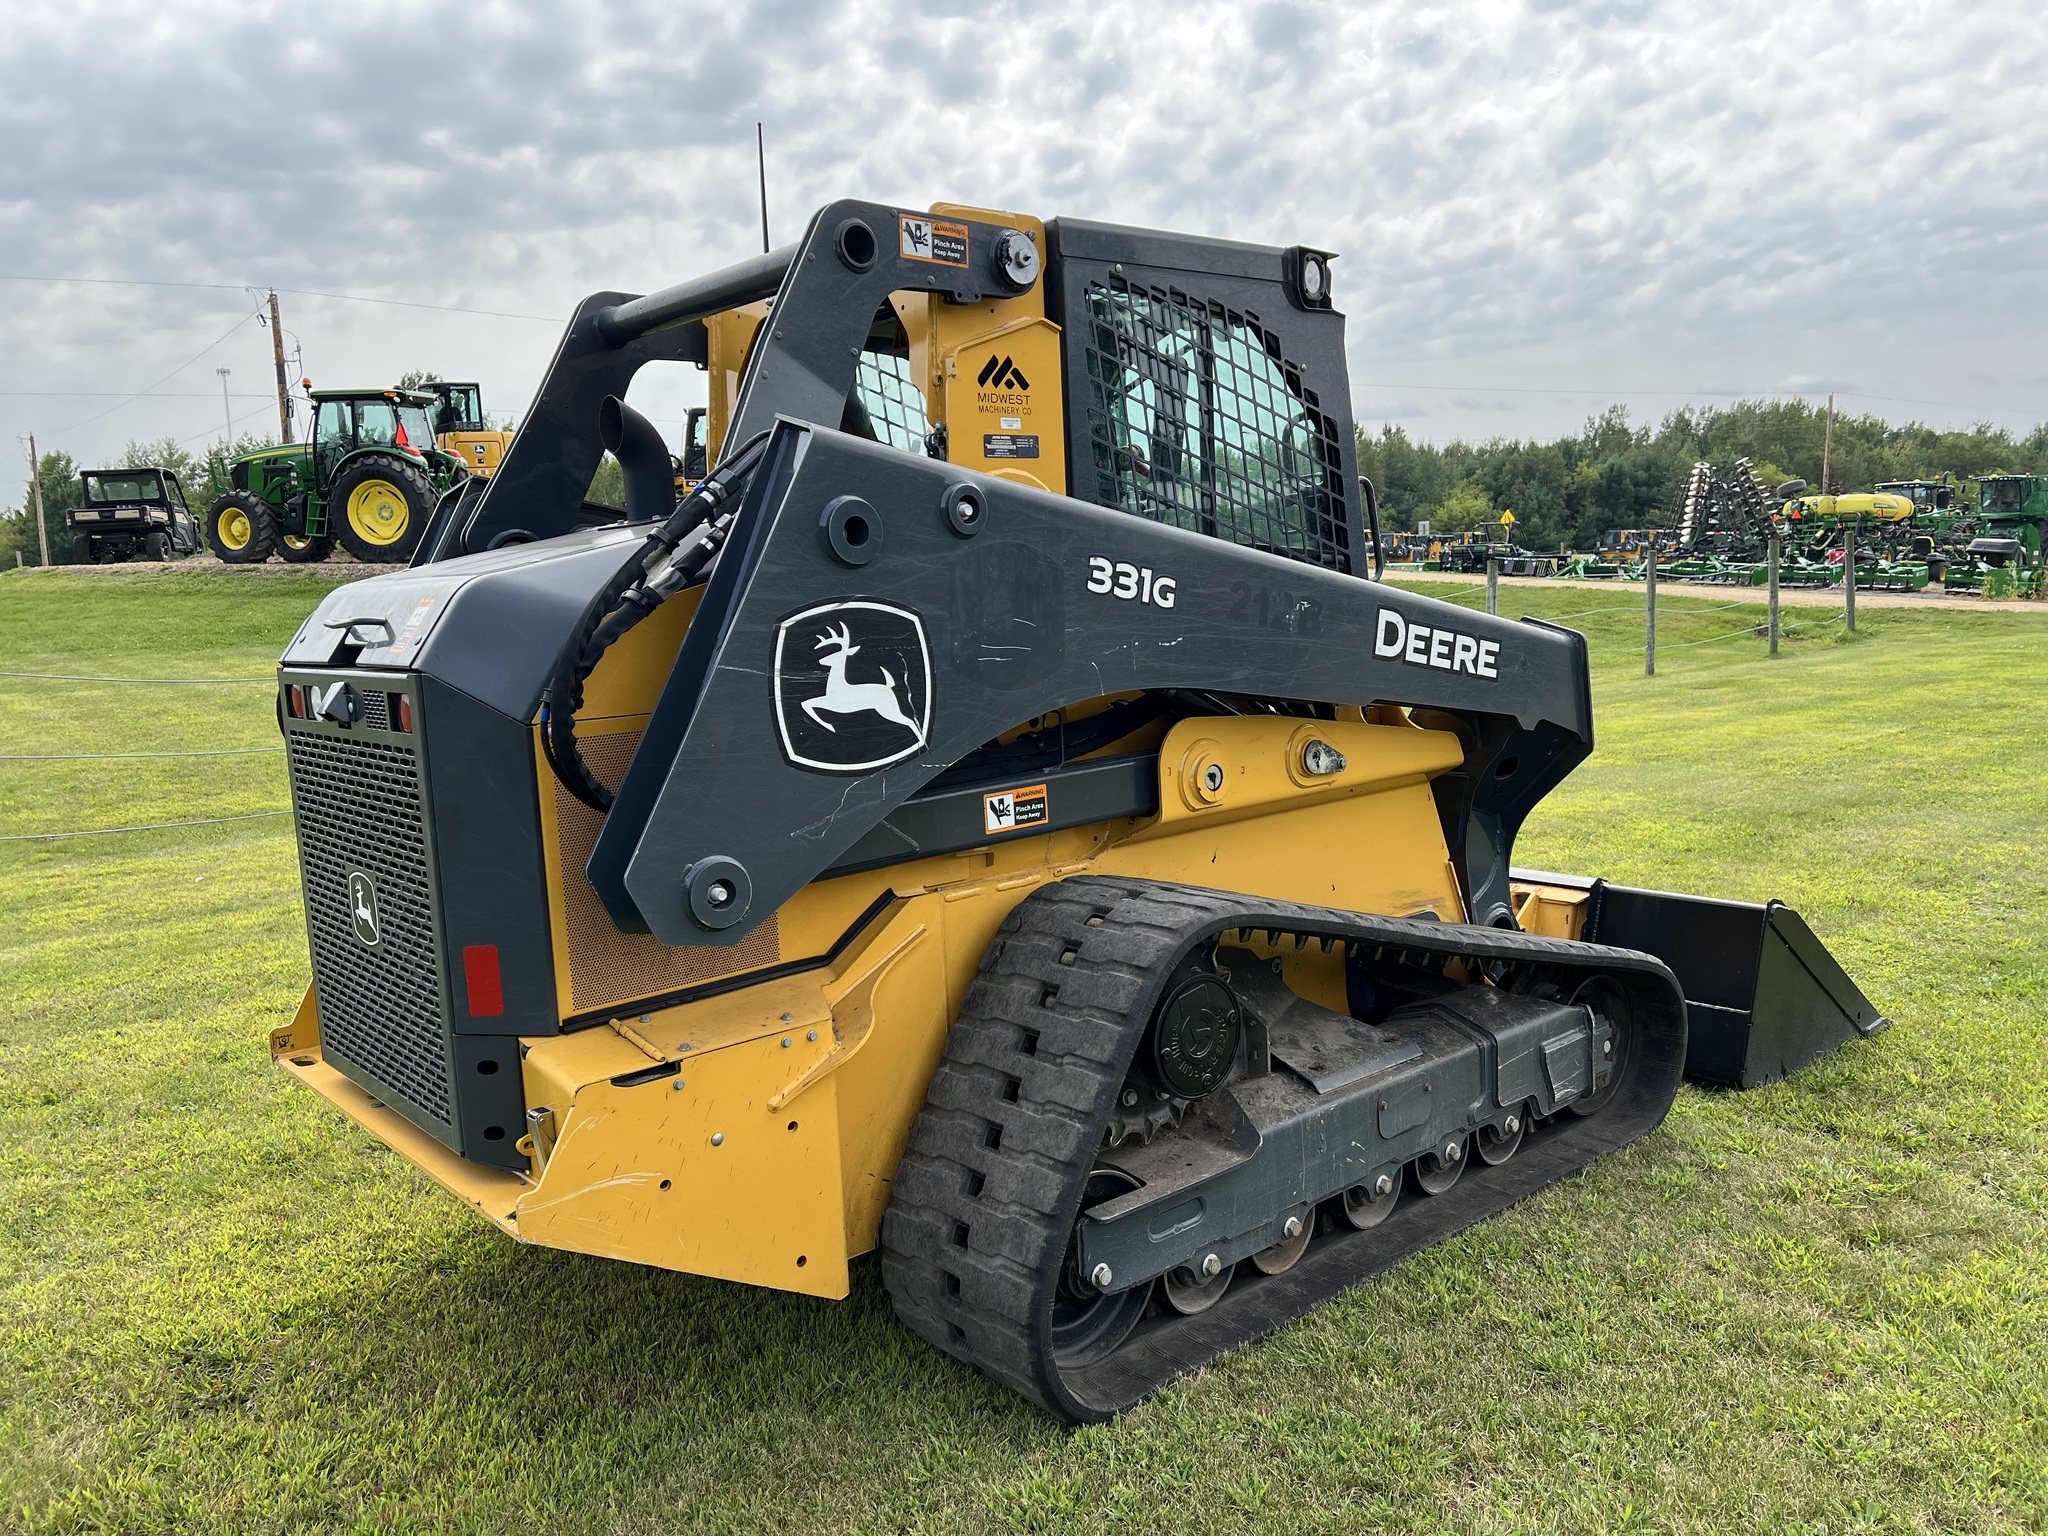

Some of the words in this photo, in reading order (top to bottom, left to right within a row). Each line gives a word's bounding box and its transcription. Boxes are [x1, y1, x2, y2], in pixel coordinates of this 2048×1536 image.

[940, 225, 965, 236] WARNING
[934, 238, 950, 248] Pinch
[951, 242, 965, 251] Area
[934, 248, 947, 257] Keep
[947, 251, 960, 259] Away
[977, 392, 1031, 405] MIDWEST
[978, 405, 1020, 415] MACHINERY
[1022, 407, 1032, 416] CO
[1087, 556, 1176, 608] 331G
[1375, 608, 1500, 679] DEERE
[1020, 788, 1044, 798] WARNING
[1015, 805, 1031, 813] Pinch
